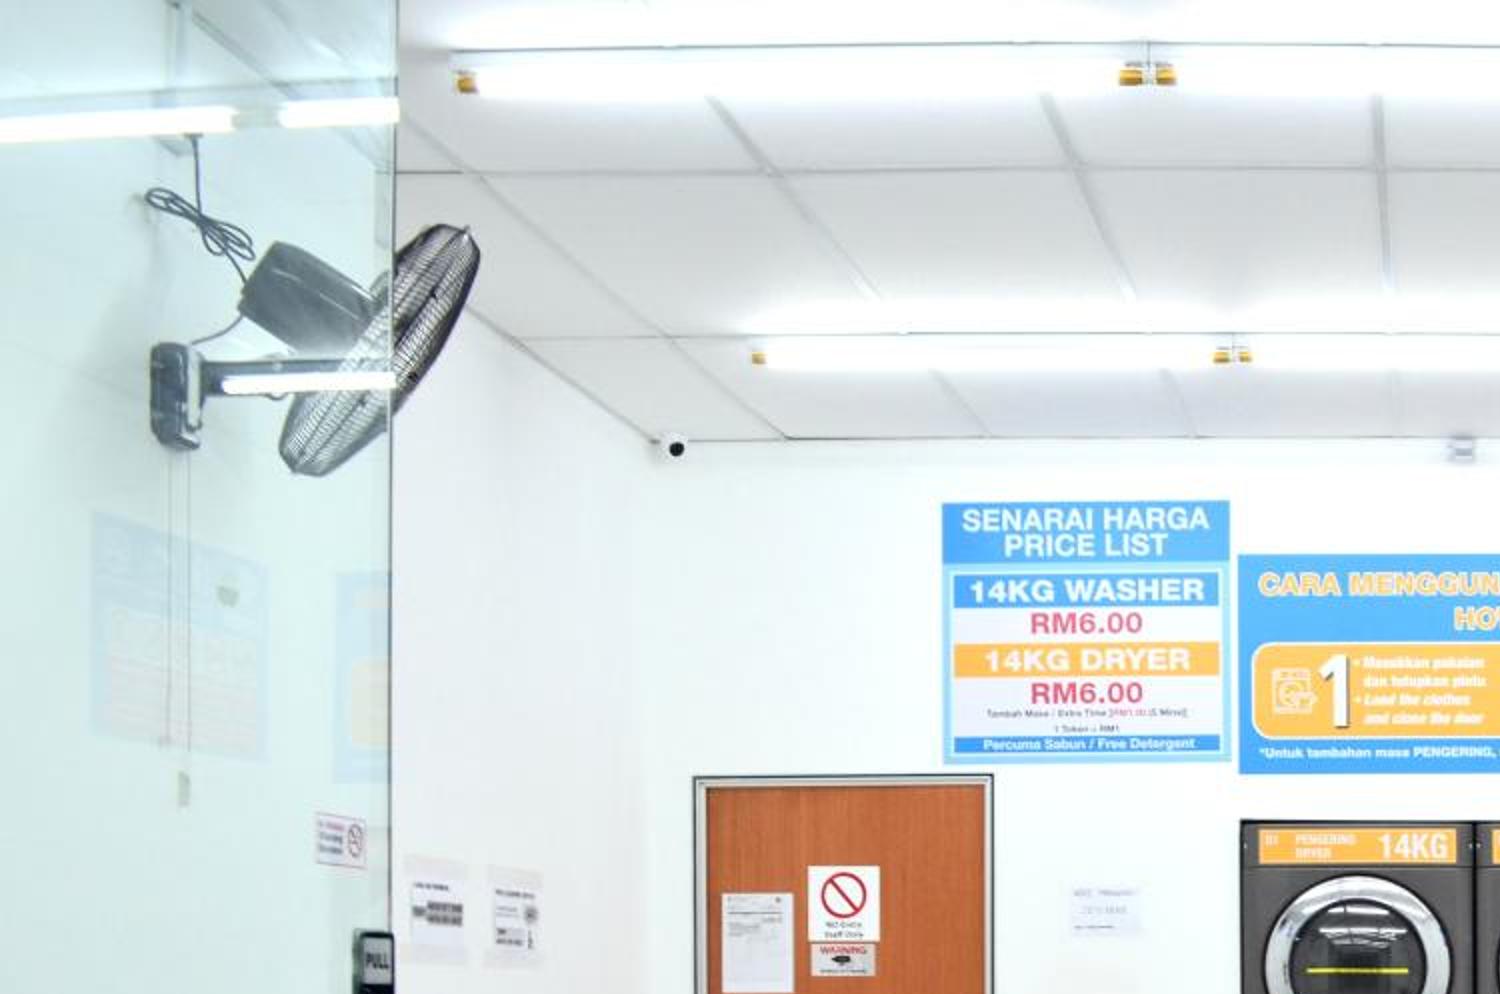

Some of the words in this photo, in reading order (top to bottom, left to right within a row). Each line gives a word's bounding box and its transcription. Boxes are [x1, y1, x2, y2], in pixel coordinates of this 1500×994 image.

[962, 508, 1093, 532] SENARAI
[1103, 507, 1210, 530] HARGA
[1004, 534, 1096, 558] PRICE
[1105, 533, 1168, 557] LIST
[970, 580, 1055, 602] 14KG
[1065, 579, 1205, 601] WASHER
[1259, 572, 1342, 597] CARA
[1031, 612, 1143, 634] RM6.00
[985, 649, 1070, 672] 14KG
[1081, 648, 1190, 671] DRYER
[1031, 682, 1143, 704] RM6.00
[1318, 654, 1350, 728] 1
[1084, 709, 1107, 717] Time
[984, 739, 1042, 751] Percuma
[1045, 739, 1086, 750] Sabun
[1098, 738, 1127, 749] Free
[1131, 738, 1197, 751] Detergent
[1305, 748, 1372, 758] tambahan
[1375, 749, 1409, 758] masa
[1413, 746, 1497, 759] PENGERING,
[1378, 833, 1449, 860] 14KG
[366, 952, 390, 969] PULL
